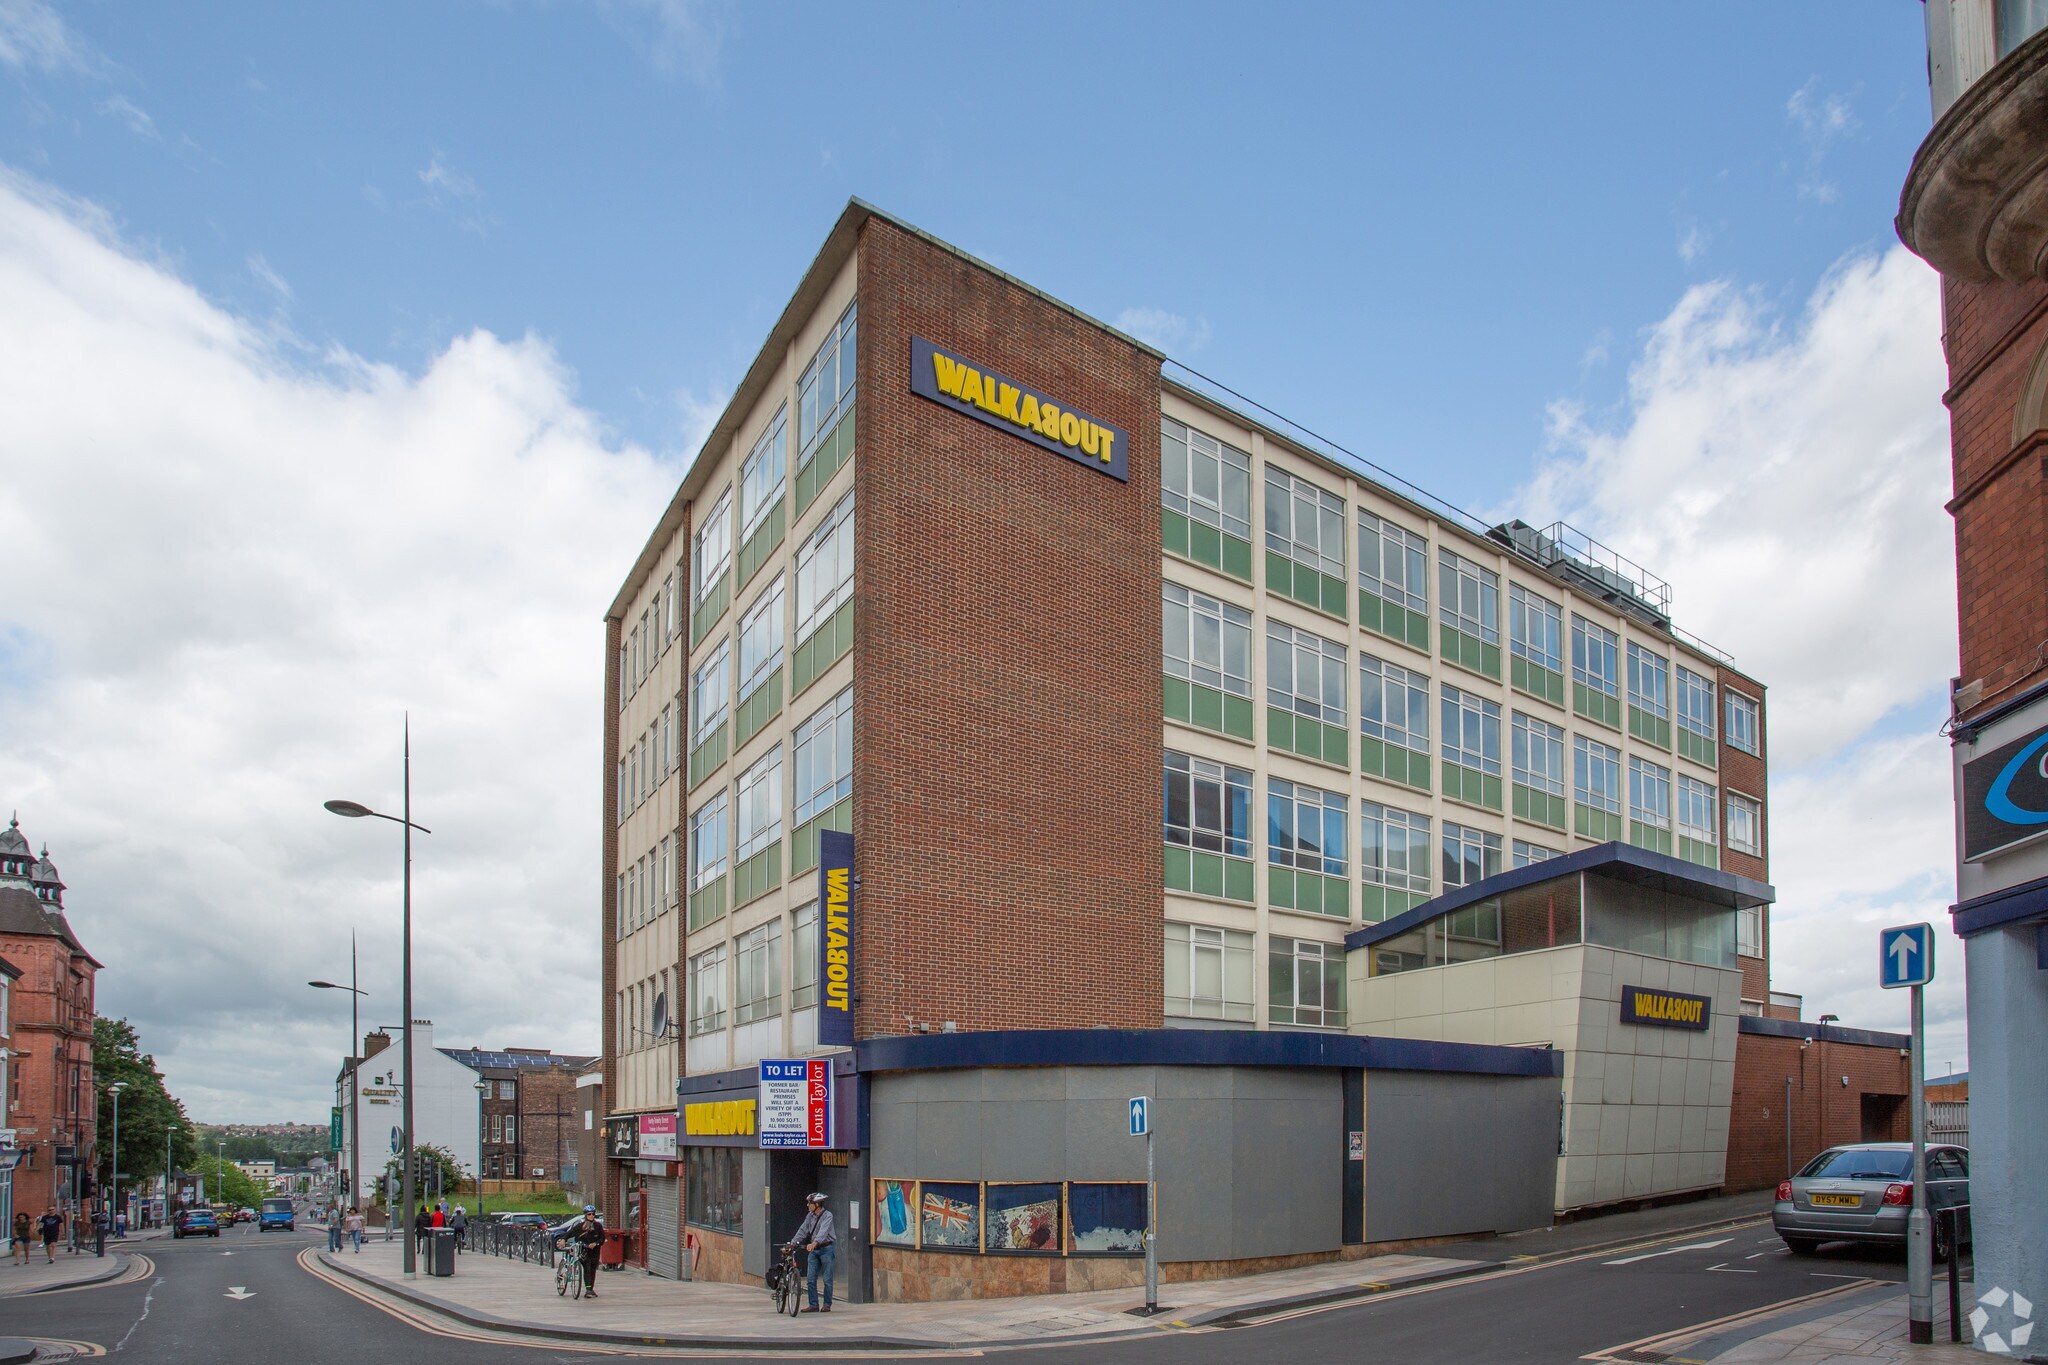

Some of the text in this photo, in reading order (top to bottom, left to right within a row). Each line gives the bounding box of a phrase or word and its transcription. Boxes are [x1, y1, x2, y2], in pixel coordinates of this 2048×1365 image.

[932, 352, 1114, 464] WALKABOUT
[826, 867, 848, 1012] WALKABOUT
[1634, 992, 1703, 1023] WALKABOUT
[766, 1065, 803, 1076] TO LET
[685, 1099, 756, 1135] WALKABOUT
[810, 1064, 827, 1142] Louis Taylor
[1815, 1195, 1837, 1204] DY57
